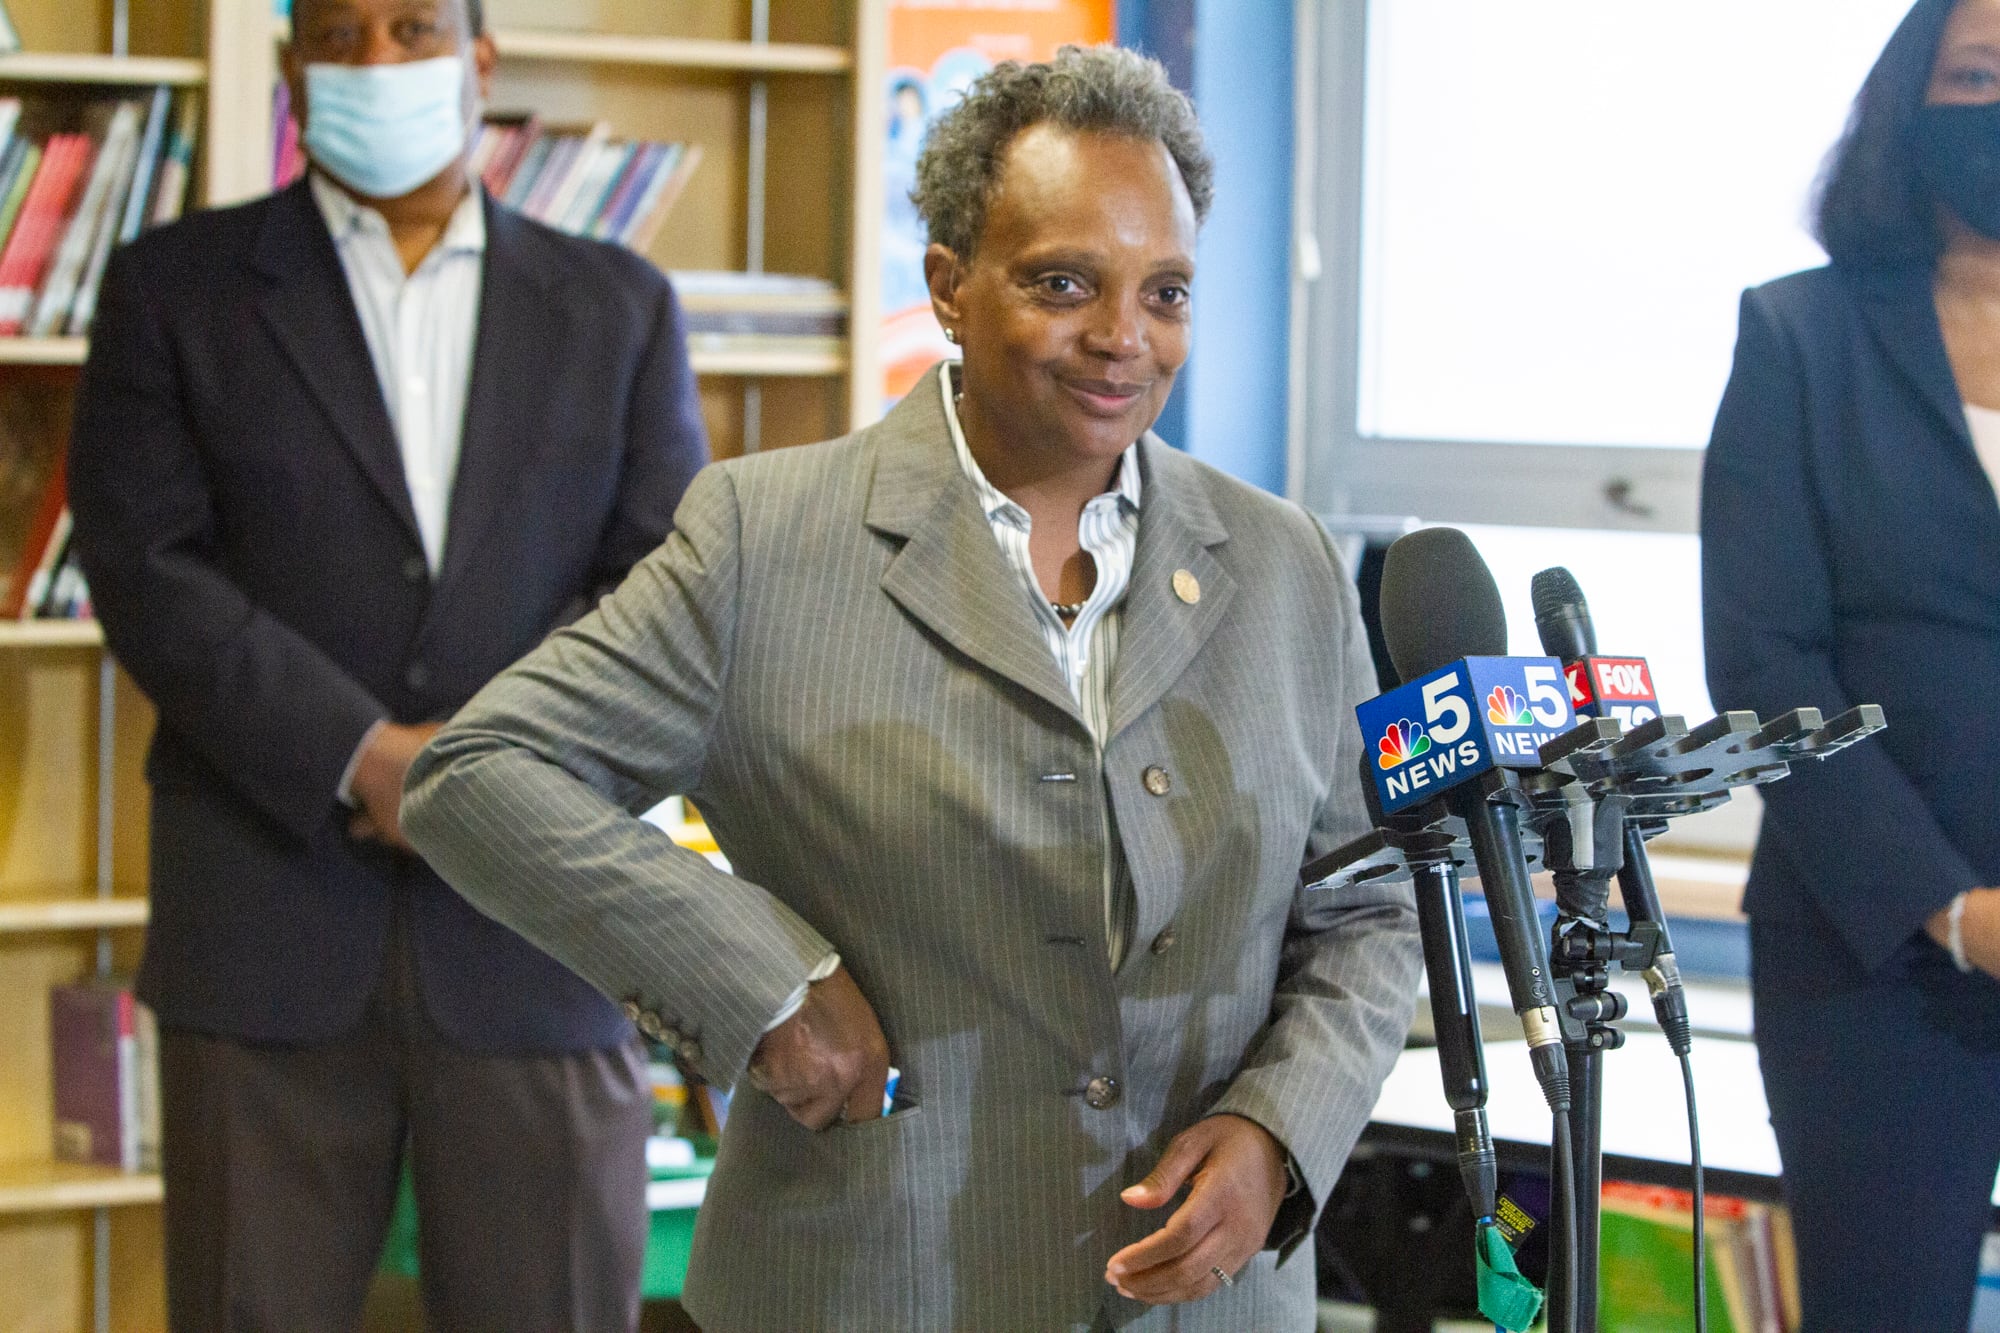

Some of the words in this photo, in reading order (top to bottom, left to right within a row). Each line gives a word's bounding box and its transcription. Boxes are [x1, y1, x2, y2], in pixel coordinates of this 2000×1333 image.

[1421, 671, 1471, 744] 5
[1524, 666, 1568, 728] 5
[1598, 664, 1649, 696] FOX
[1385, 740, 1480, 800] NEWS
[1495, 732, 1565, 755] NEW
